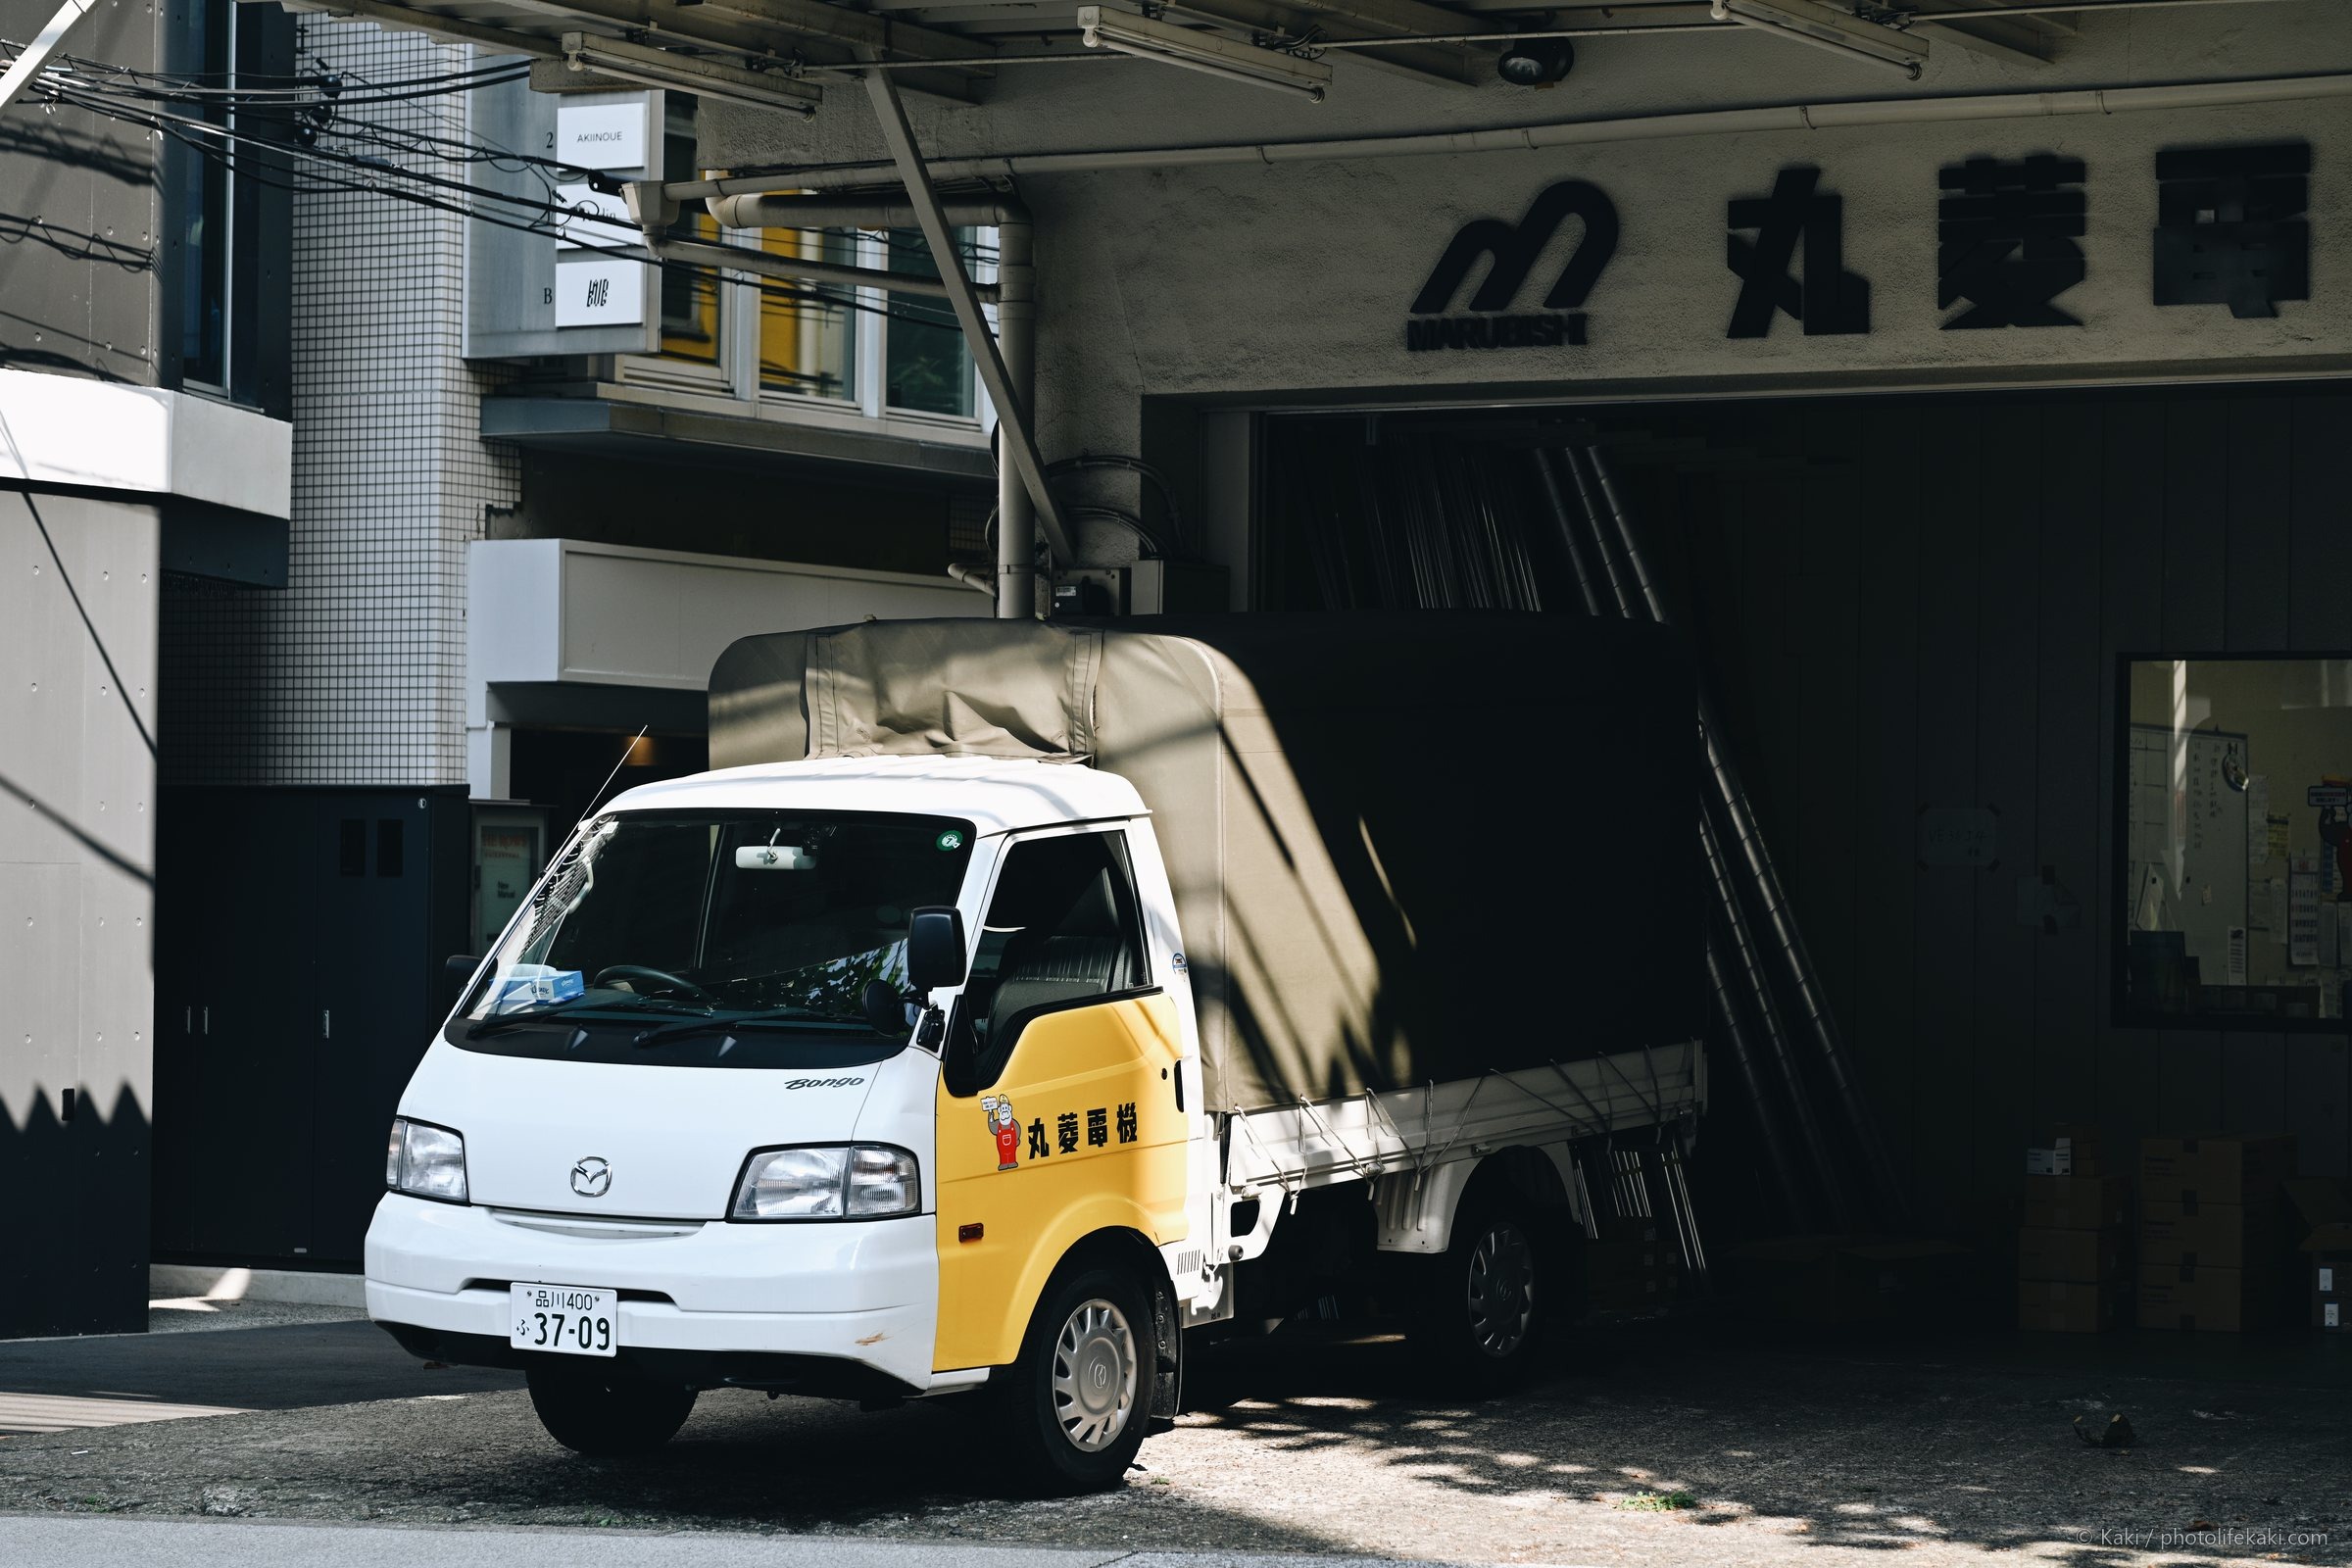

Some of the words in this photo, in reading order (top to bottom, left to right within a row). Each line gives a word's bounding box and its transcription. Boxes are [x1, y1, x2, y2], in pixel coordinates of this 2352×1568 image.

[546, 131, 554, 149] 2
[576, 131, 623, 143] AKIINOUE
[544, 287, 553, 305] B
[1407, 313, 1588, 351] MARUBISHI
[784, 1077, 864, 1090] Bongo
[1028, 1102, 1138, 1160] 丸菱電機
[534, 1312, 611, 1350] 37-09
